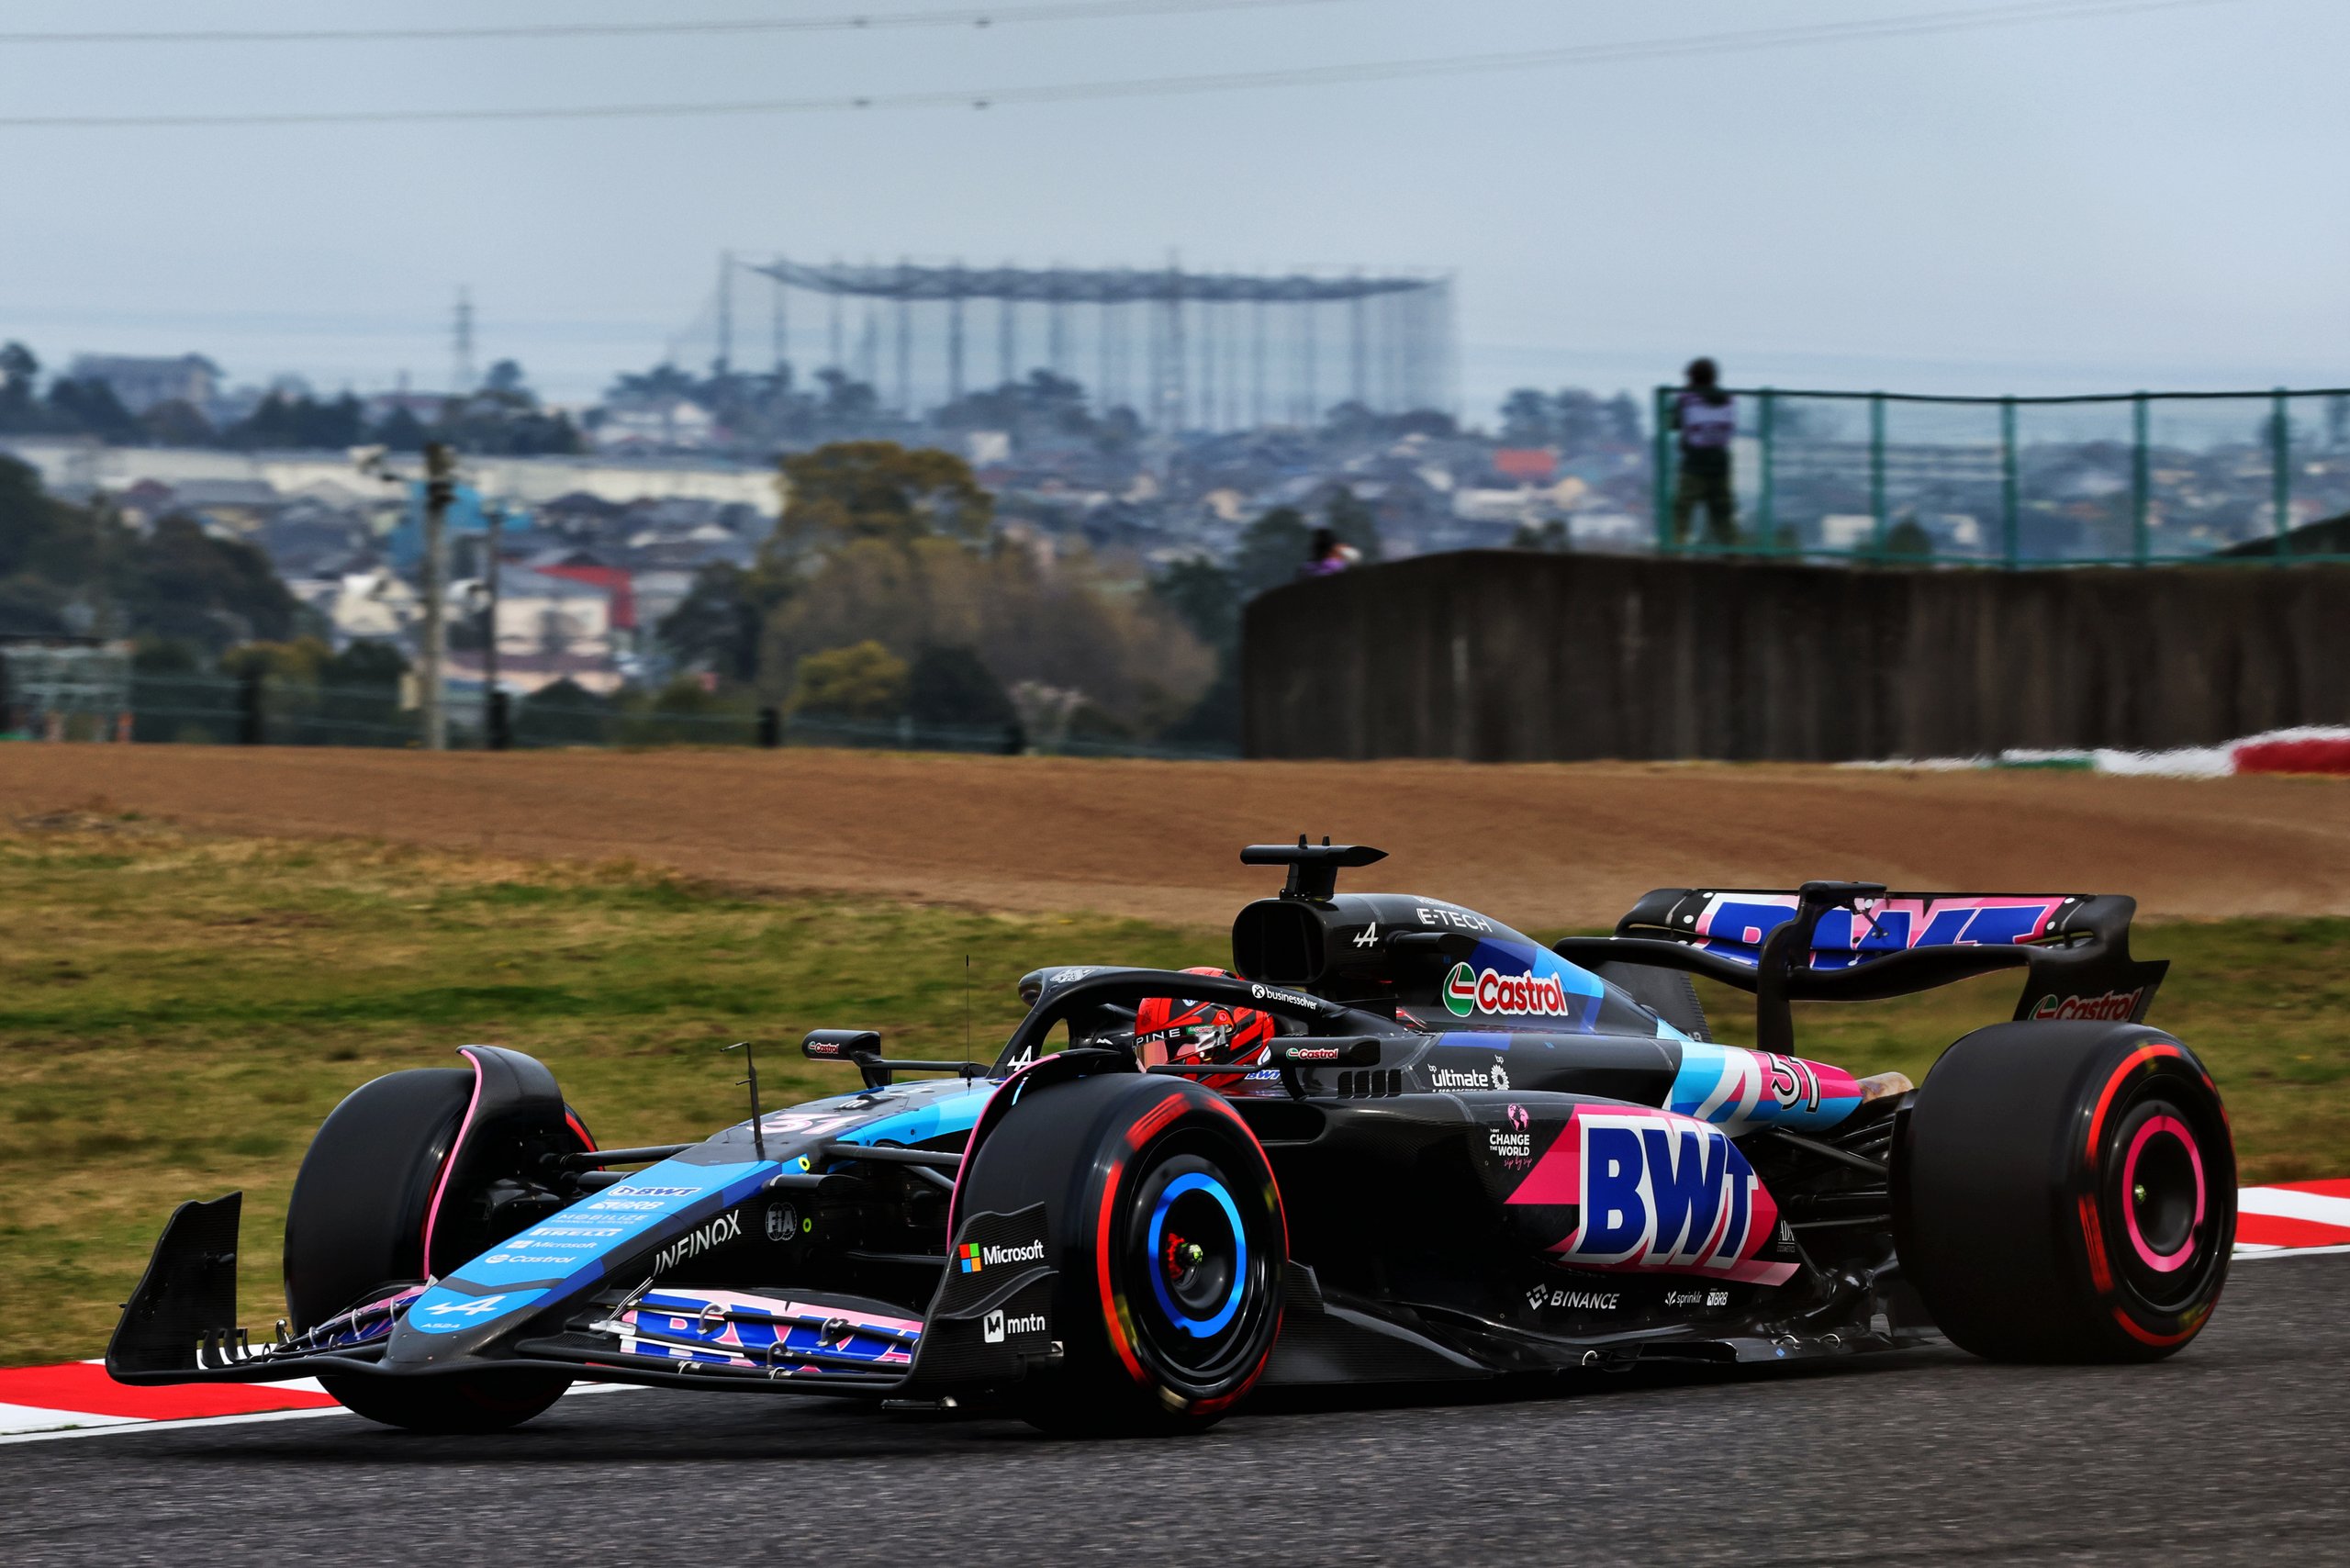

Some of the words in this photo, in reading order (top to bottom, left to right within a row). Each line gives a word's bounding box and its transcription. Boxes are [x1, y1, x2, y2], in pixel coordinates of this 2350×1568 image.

[1416, 907, 1493, 933] E-TECH
[1266, 986, 1317, 1010] businessolver
[1475, 968, 1569, 1016] Castrol
[2054, 986, 2144, 1021] Castrol
[815, 1042, 840, 1055] Castrol
[1298, 1048, 1338, 1059] Castrol
[1432, 1069, 1488, 1087] ultimate
[1489, 1134, 1530, 1146] CHANGE
[1498, 1146, 1530, 1157] WORLD
[636, 1186, 702, 1197] BWT
[1559, 1114, 1759, 1270] BWT
[767, 1210, 795, 1233] FIA
[530, 1227, 623, 1237] PIRELLI
[509, 1255, 576, 1263] Castrol
[983, 1239, 1045, 1265] Microsoft
[1550, 1291, 1620, 1310] BINANCE
[1676, 1291, 1703, 1308] sprinklr
[1007, 1314, 1046, 1334] mntn
